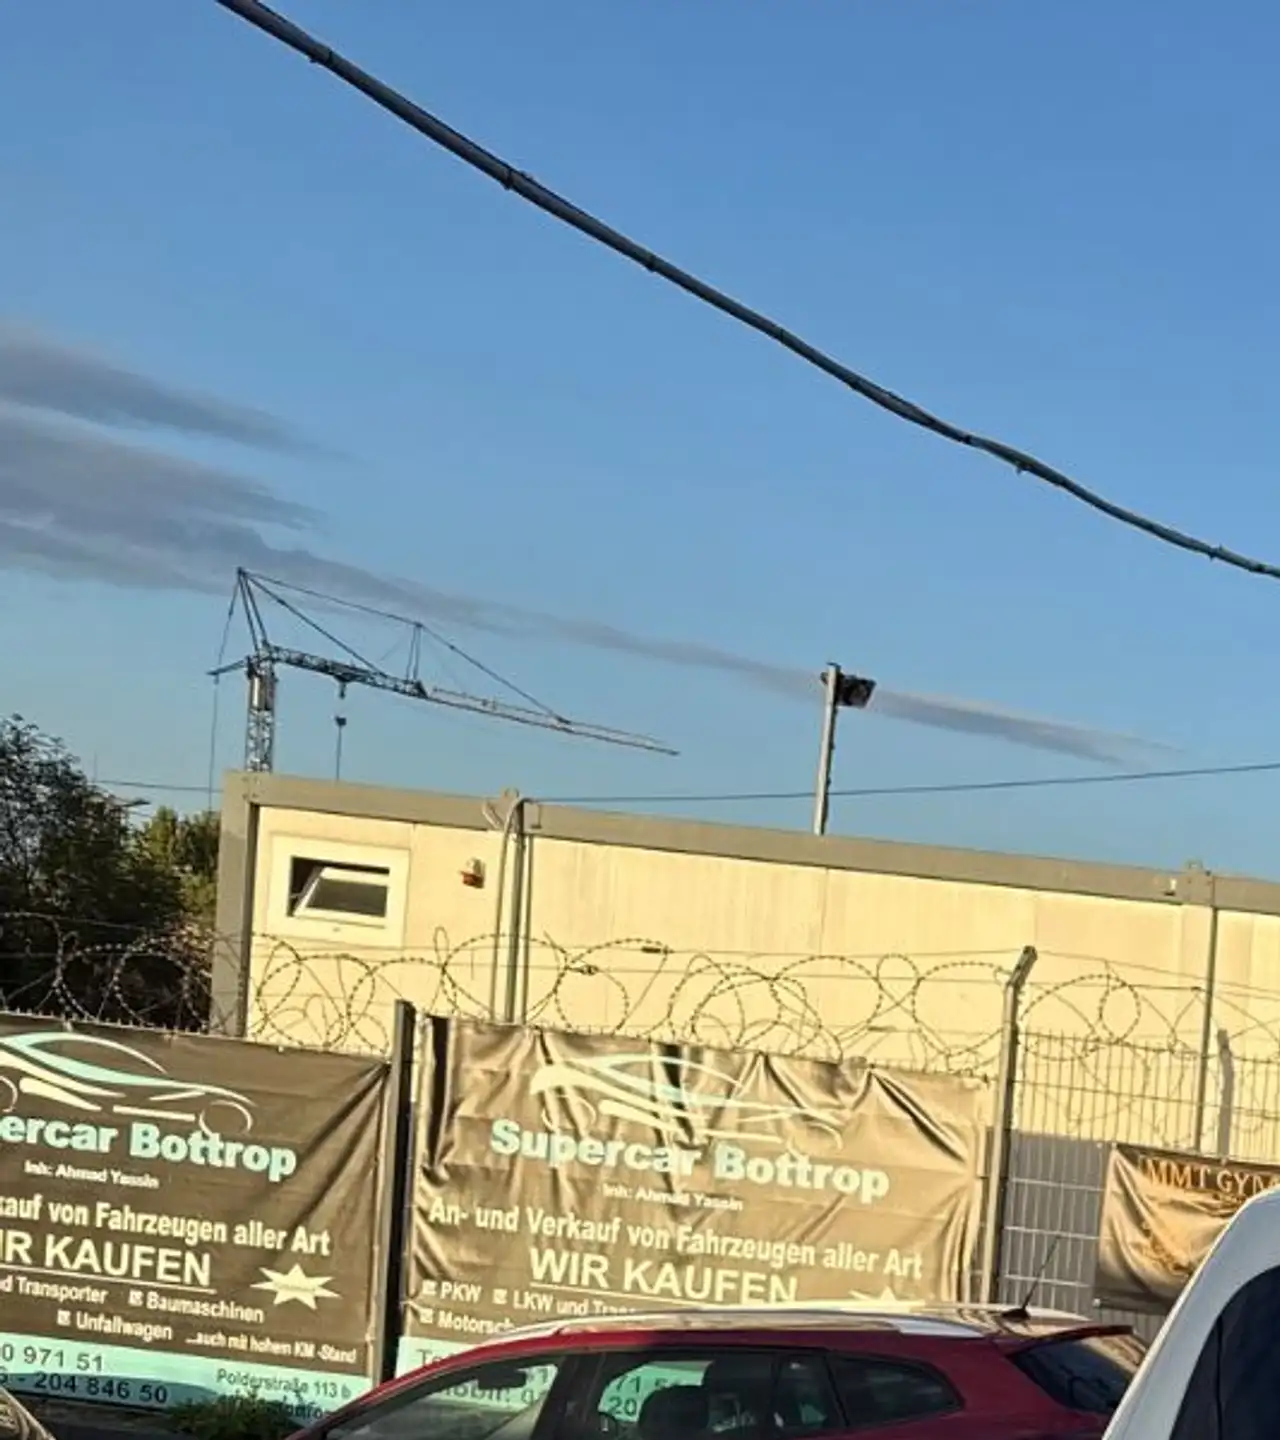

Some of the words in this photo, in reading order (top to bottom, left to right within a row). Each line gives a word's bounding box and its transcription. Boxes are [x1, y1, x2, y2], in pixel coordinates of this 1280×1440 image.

[129, 1121, 297, 1181] Bottrop
[490, 1118, 702, 1176] Supercar
[714, 1143, 890, 1204] Bottrop
[48, 1202, 89, 1226] von
[96, 1202, 227, 1246] Fahrzeugen
[233, 1220, 288, 1249] aller
[291, 1226, 331, 1256] Art
[428, 1197, 468, 1226] An-
[475, 1204, 519, 1232] und
[526, 1206, 622, 1243] Verkauf
[626, 1223, 669, 1250] von
[676, 1225, 816, 1269] Fahrzeugen
[823, 1242, 880, 1272] aller
[883, 1248, 923, 1280] Art
[44, 1234, 211, 1287] KAUFEN
[529, 1247, 610, 1289] WIR
[623, 1257, 798, 1304] KAUFEN
[16, 1276, 109, 1304] Transporter
[146, 1291, 265, 1324] Baumaschinen
[440, 1281, 482, 1303] PKW
[513, 1290, 553, 1313] LKW
[556, 1299, 588, 1316] und
[75, 1311, 172, 1342] Unfallwagen
[24, 1346, 64, 1368] 971
[76, 1353, 104, 1372] 51
[34, 1370, 77, 1393] 204
[86, 1376, 130, 1399] 846
[139, 1383, 168, 1404] 50
